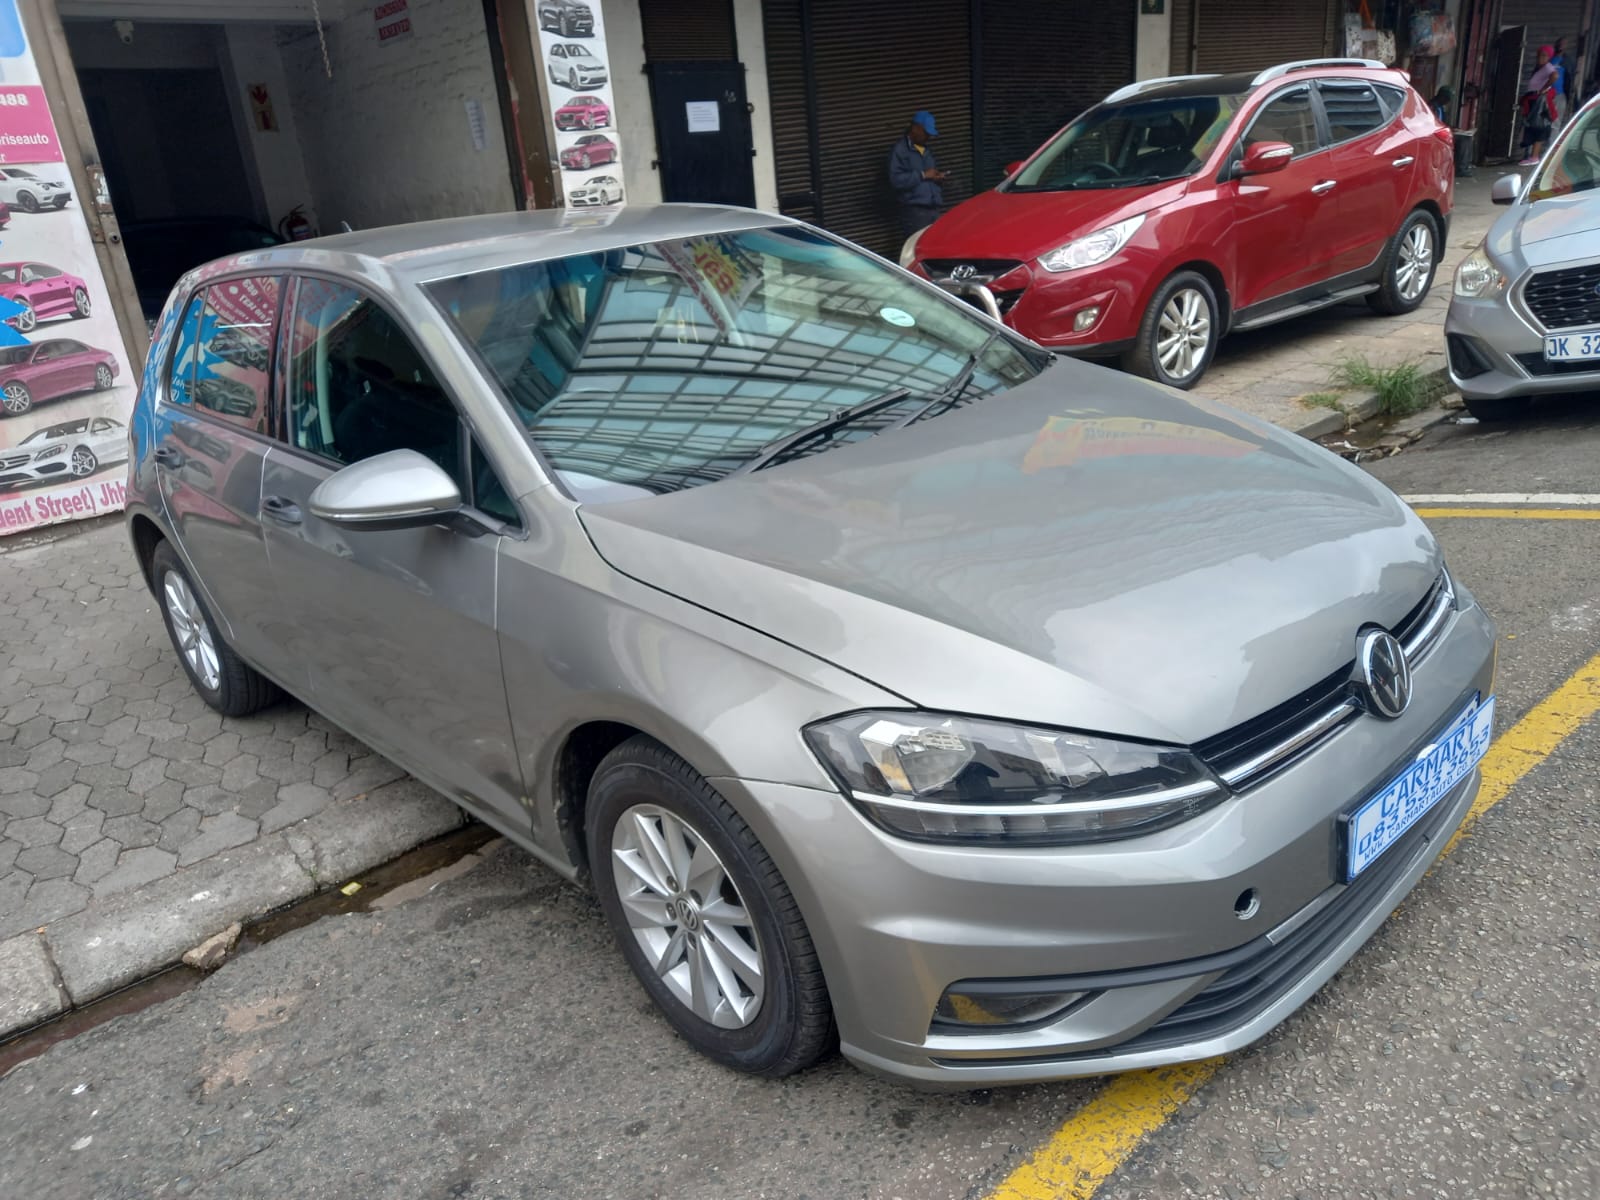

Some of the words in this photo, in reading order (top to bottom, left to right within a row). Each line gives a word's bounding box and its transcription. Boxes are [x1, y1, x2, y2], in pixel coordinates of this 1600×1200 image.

[0, 132, 49, 145] riseauto
[1547, 338, 1570, 357] JK
[35, 485, 97, 516] Street)
[1380, 716, 1478, 818] CARMART
[1358, 808, 1400, 855] 083
[1404, 769, 1443, 813] 533
